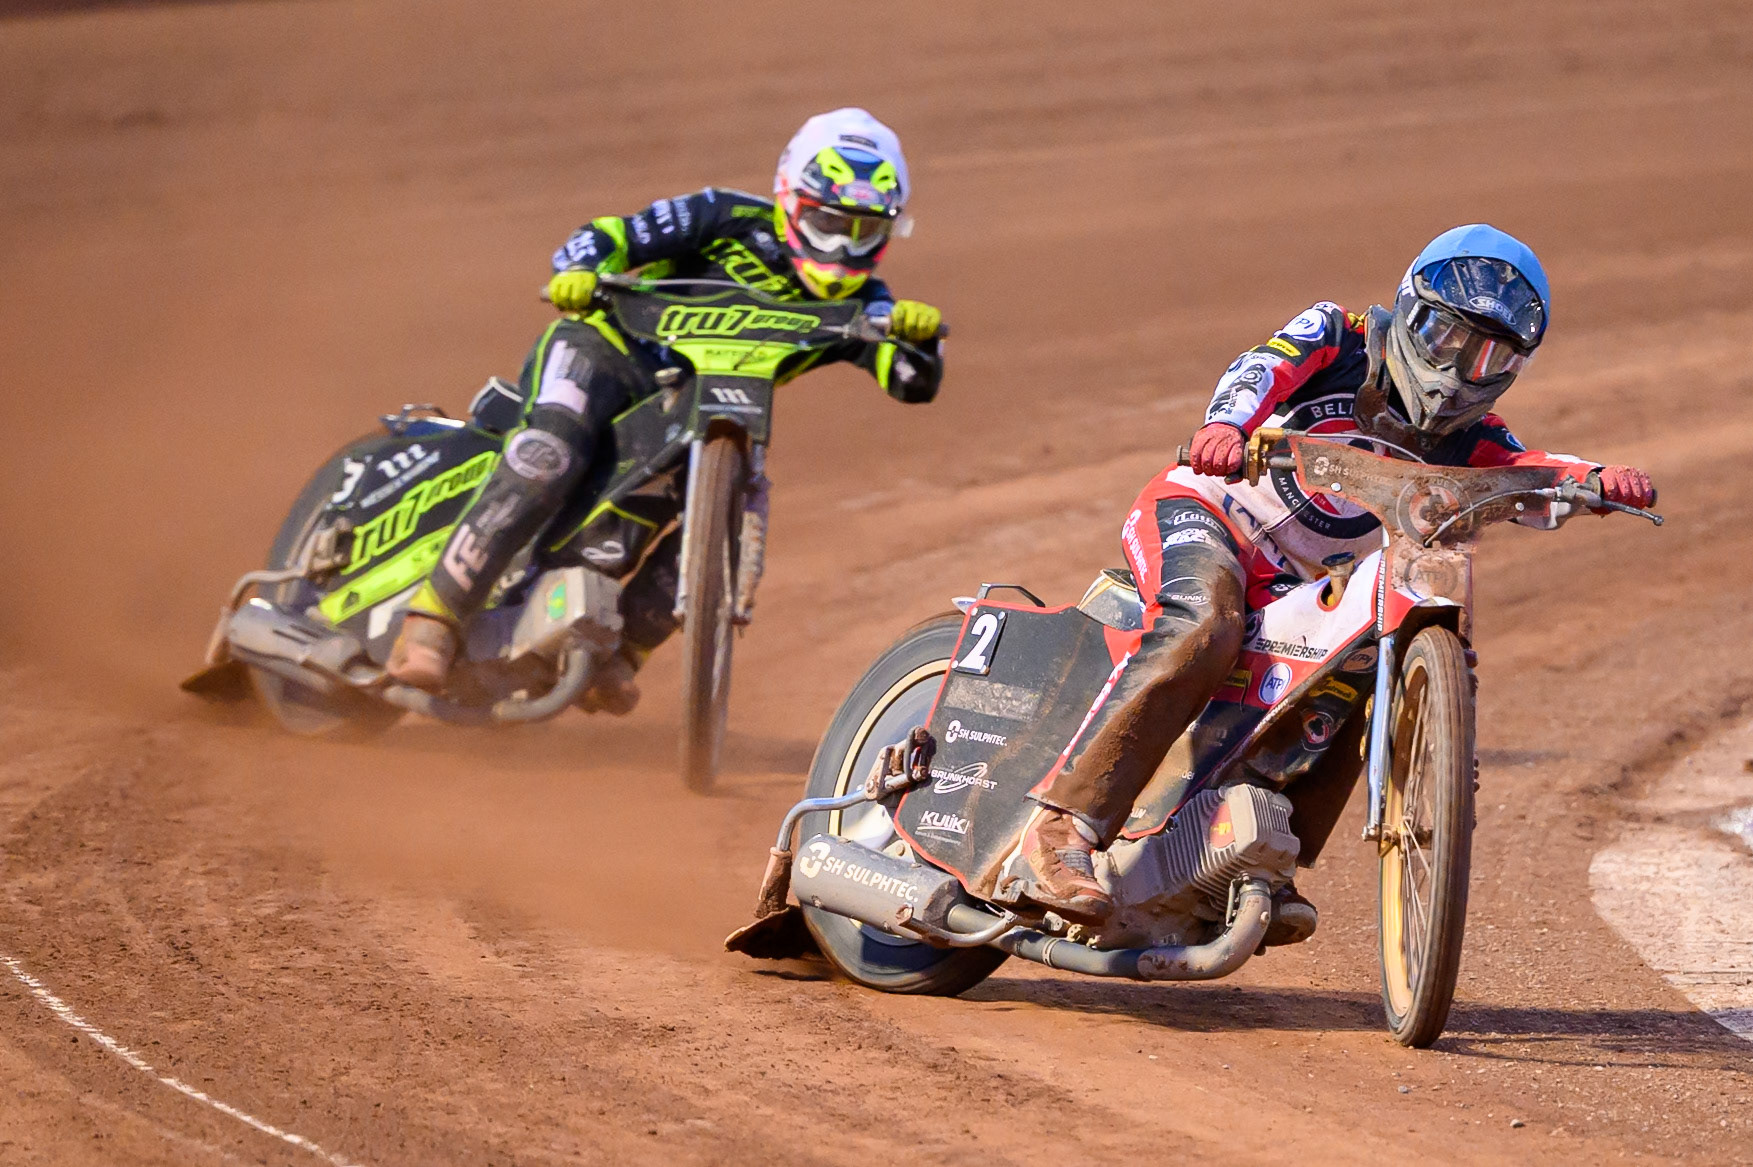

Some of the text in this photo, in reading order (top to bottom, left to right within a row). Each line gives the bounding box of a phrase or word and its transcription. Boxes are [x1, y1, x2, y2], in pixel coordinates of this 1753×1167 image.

[959, 613, 999, 670] 2
[1261, 639, 1328, 660] PREMIERSHIP
[958, 728, 970, 740] SH
[931, 769, 998, 791] BRUNKHORST
[822, 856, 843, 876] SH
